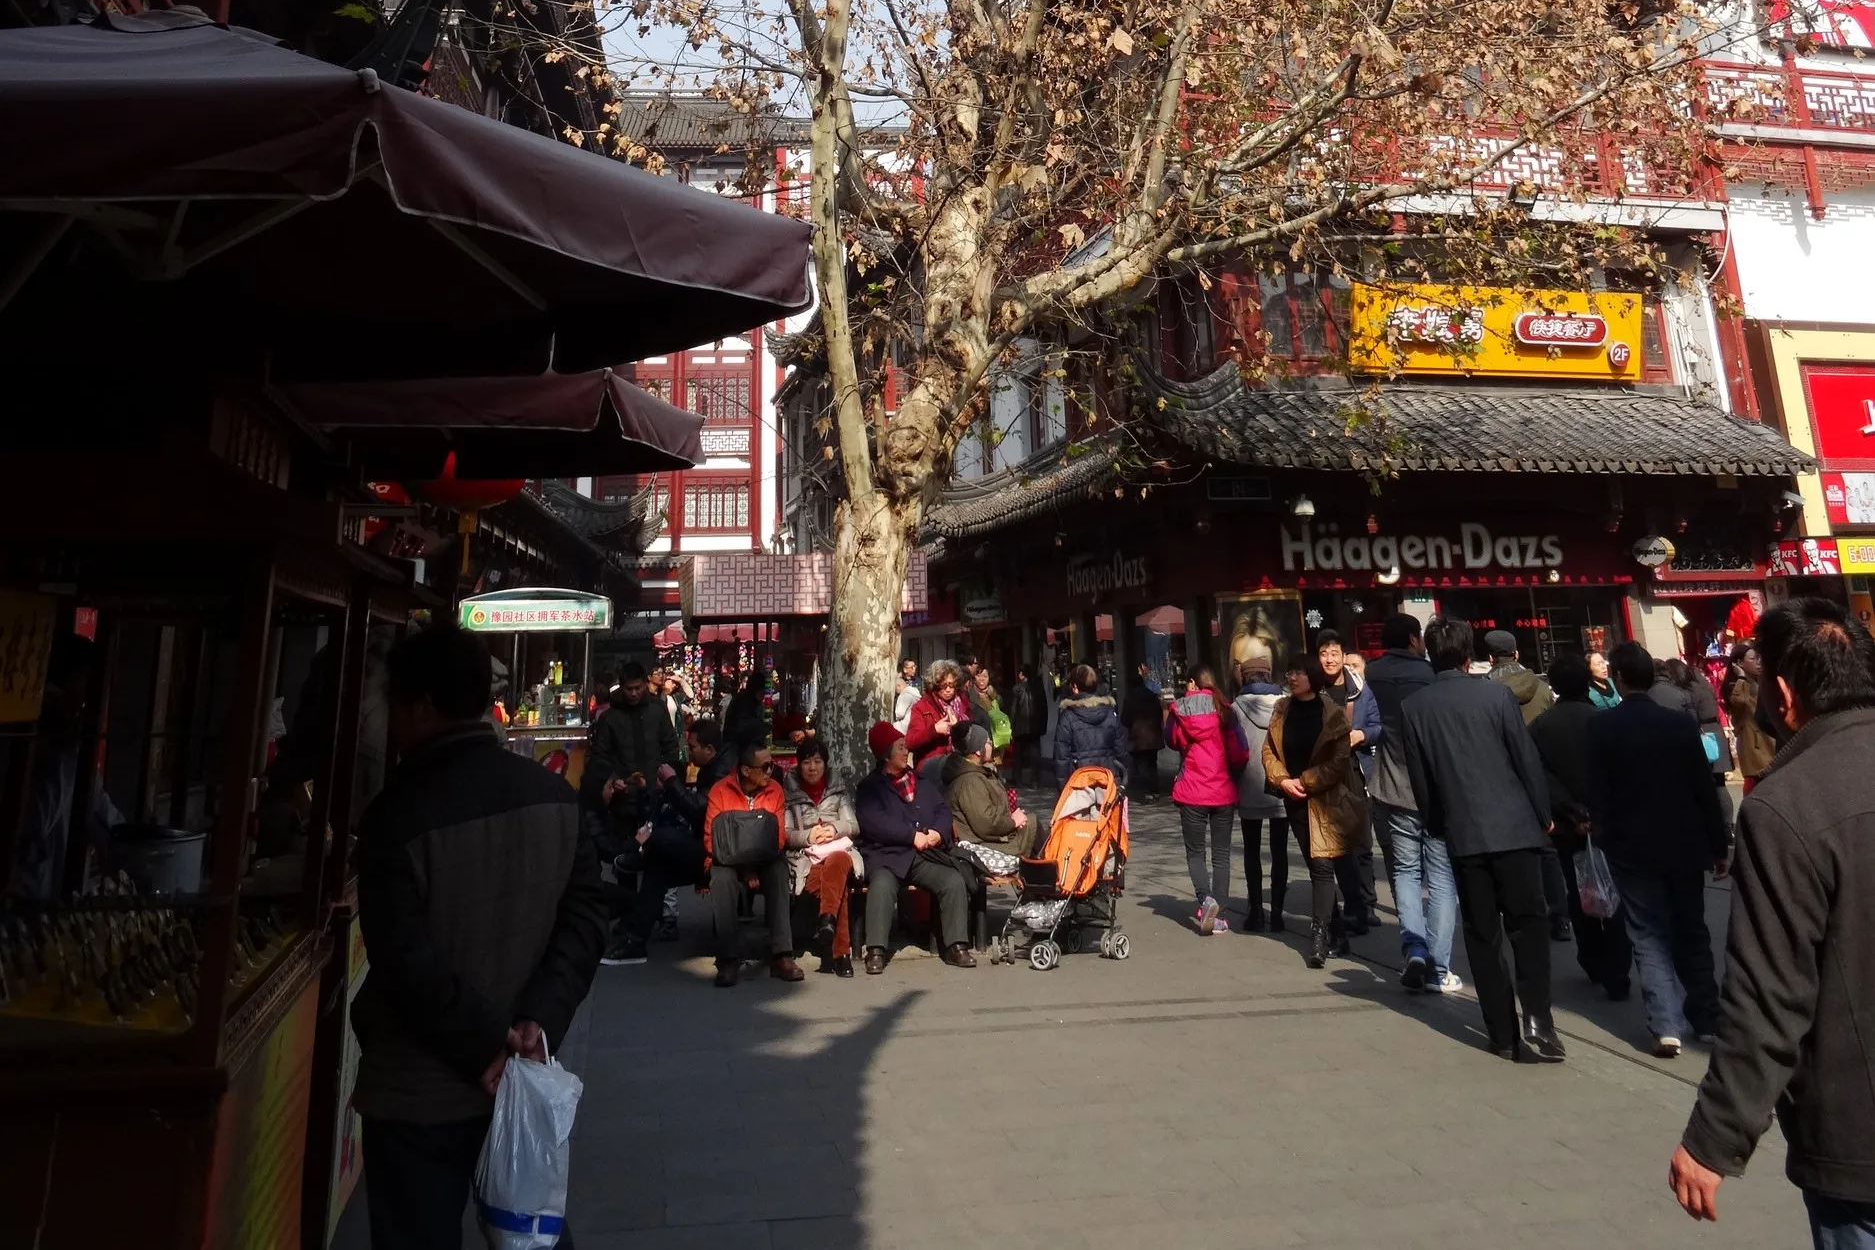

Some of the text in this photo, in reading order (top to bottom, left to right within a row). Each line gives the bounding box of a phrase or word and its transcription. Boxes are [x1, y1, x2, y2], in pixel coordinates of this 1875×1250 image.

[1530, 318, 1597, 341] 快捷餐厅
[1614, 347, 1629, 361] 2F
[1281, 522, 1564, 584] Häagen-Dazs
[1781, 549, 1798, 559] KFC
[1820, 549, 1838, 559] KFC
[490, 609, 595, 624] 豫园社区拥军茶水站
